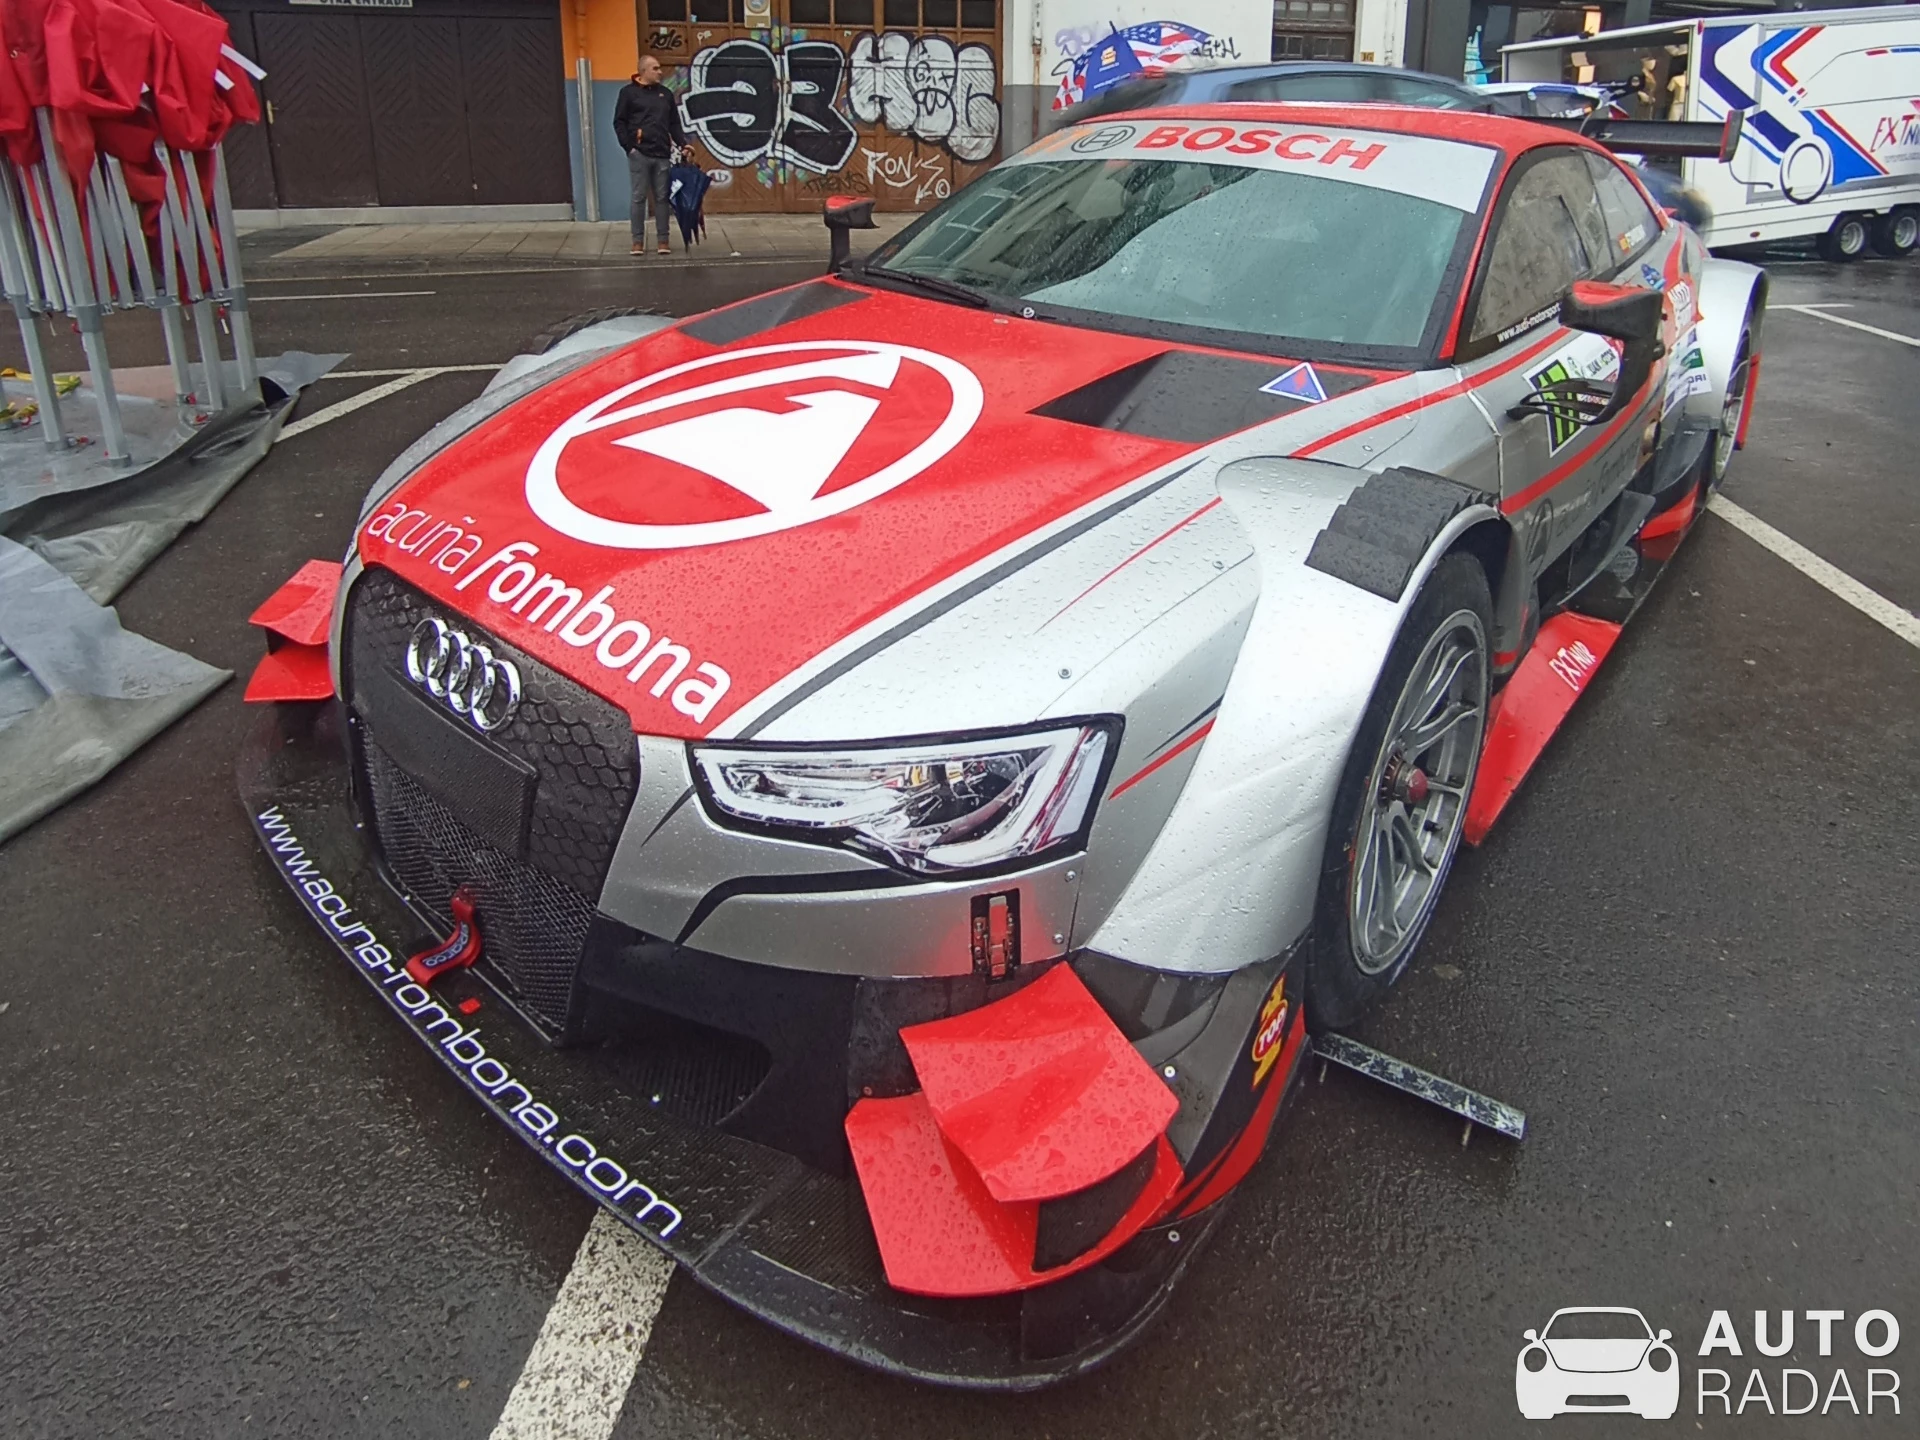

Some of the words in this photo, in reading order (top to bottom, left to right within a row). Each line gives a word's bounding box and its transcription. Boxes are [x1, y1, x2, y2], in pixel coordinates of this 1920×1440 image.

[1134, 126, 1388, 170] BOSCH
[368, 503, 483, 575] acuña
[454, 541, 731, 724] fombona
[258, 806, 682, 1237] www.acuna-fombona.com
